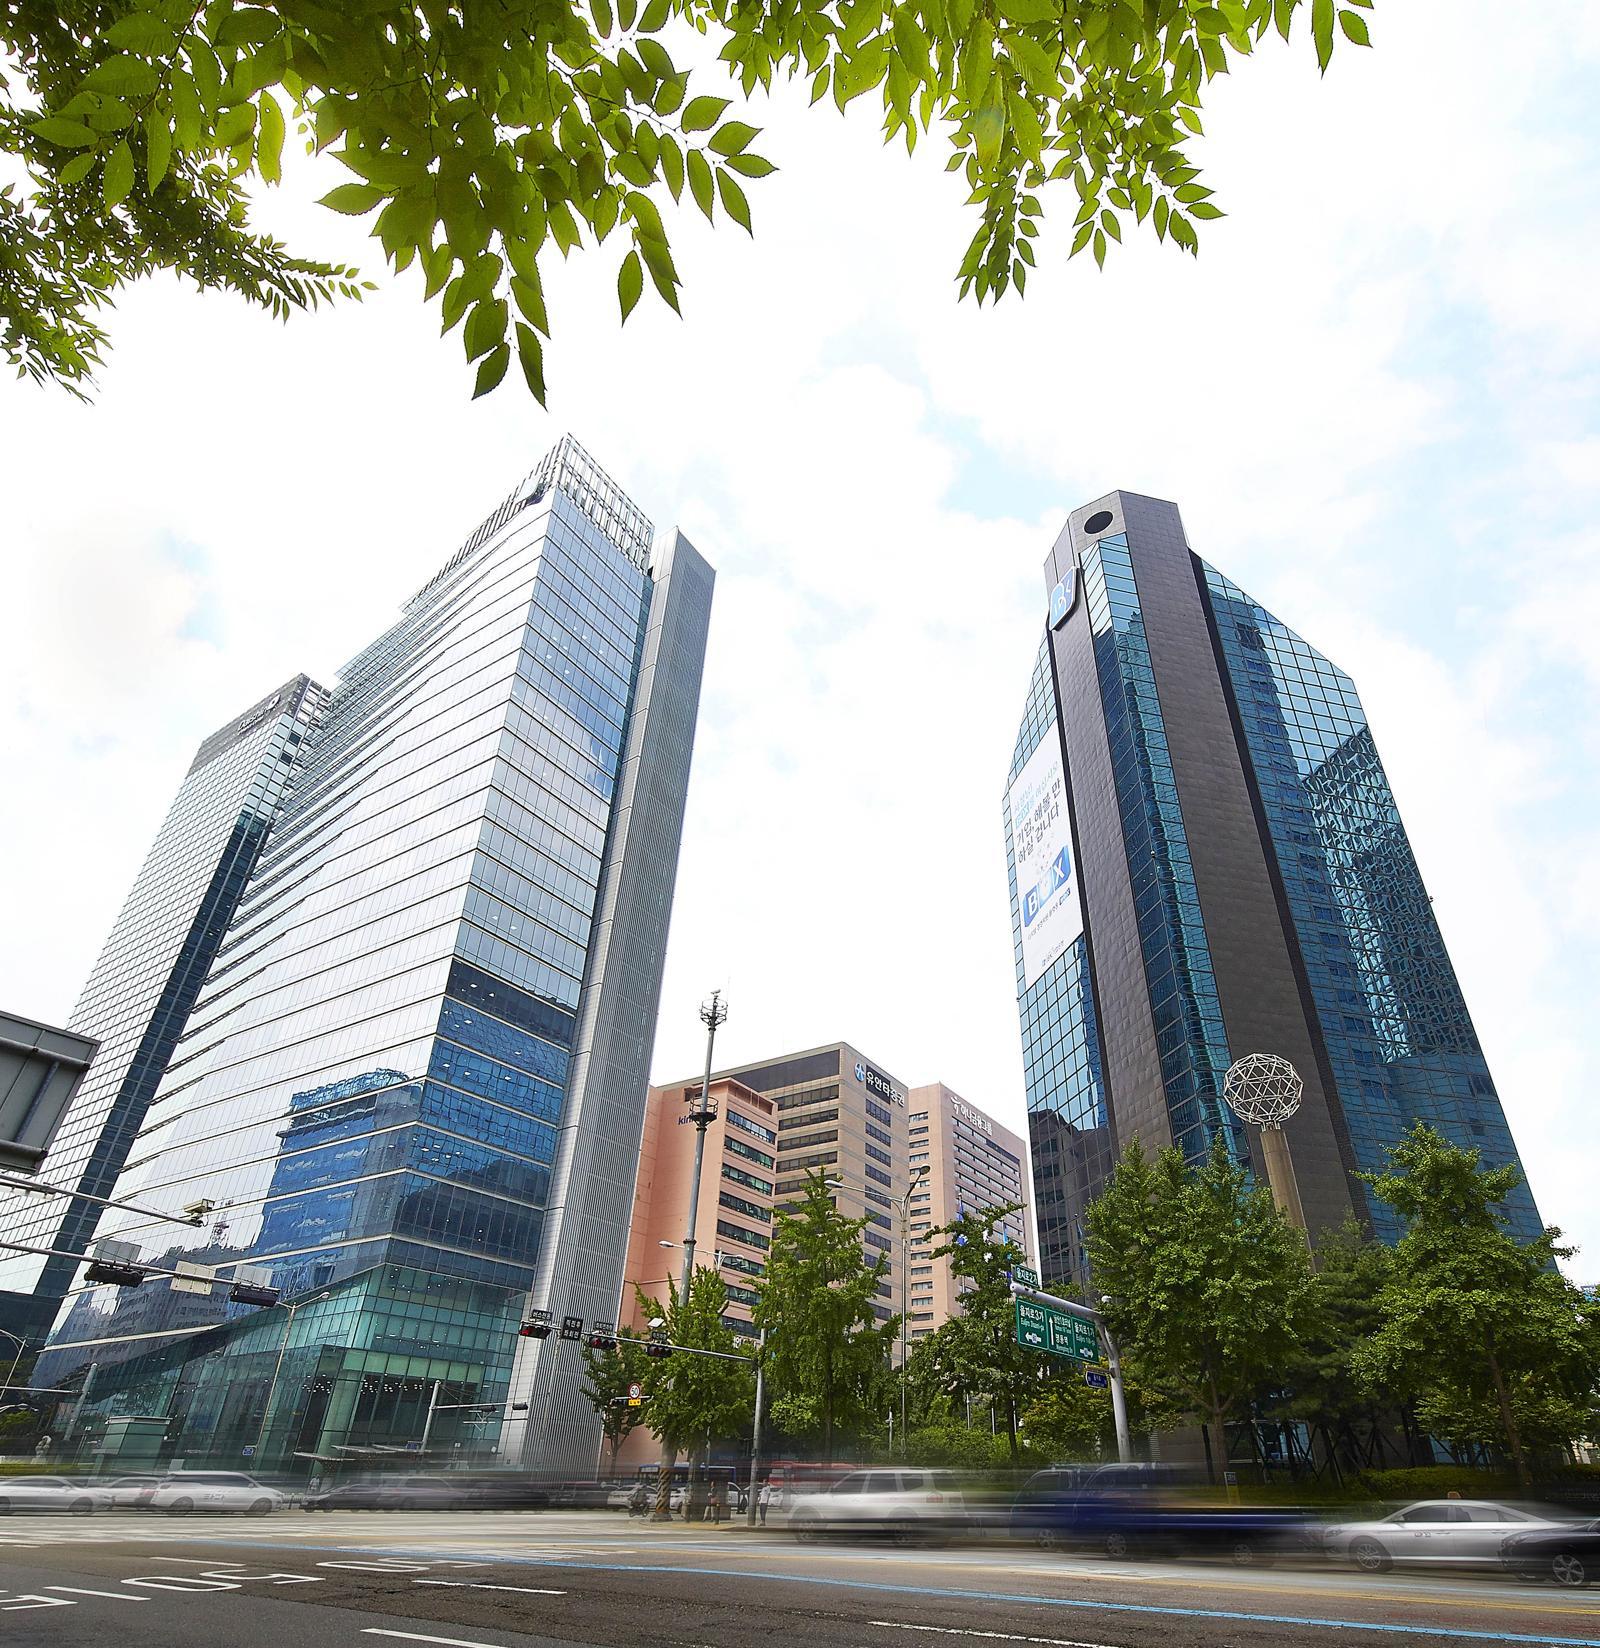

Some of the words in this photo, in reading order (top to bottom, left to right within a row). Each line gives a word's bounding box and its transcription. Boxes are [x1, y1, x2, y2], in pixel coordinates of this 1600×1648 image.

[1052, 777, 1061, 798] 만
[1017, 838, 1034, 863] 하실
[1035, 801, 1060, 843] 겁니다
[866, 1072, 905, 1107] 유안타증권
[961, 1103, 993, 1136] 하나금융그룹
[1019, 1304, 1044, 1322] 을지로3가
[1074, 1321, 1095, 1338] 을지로1가
